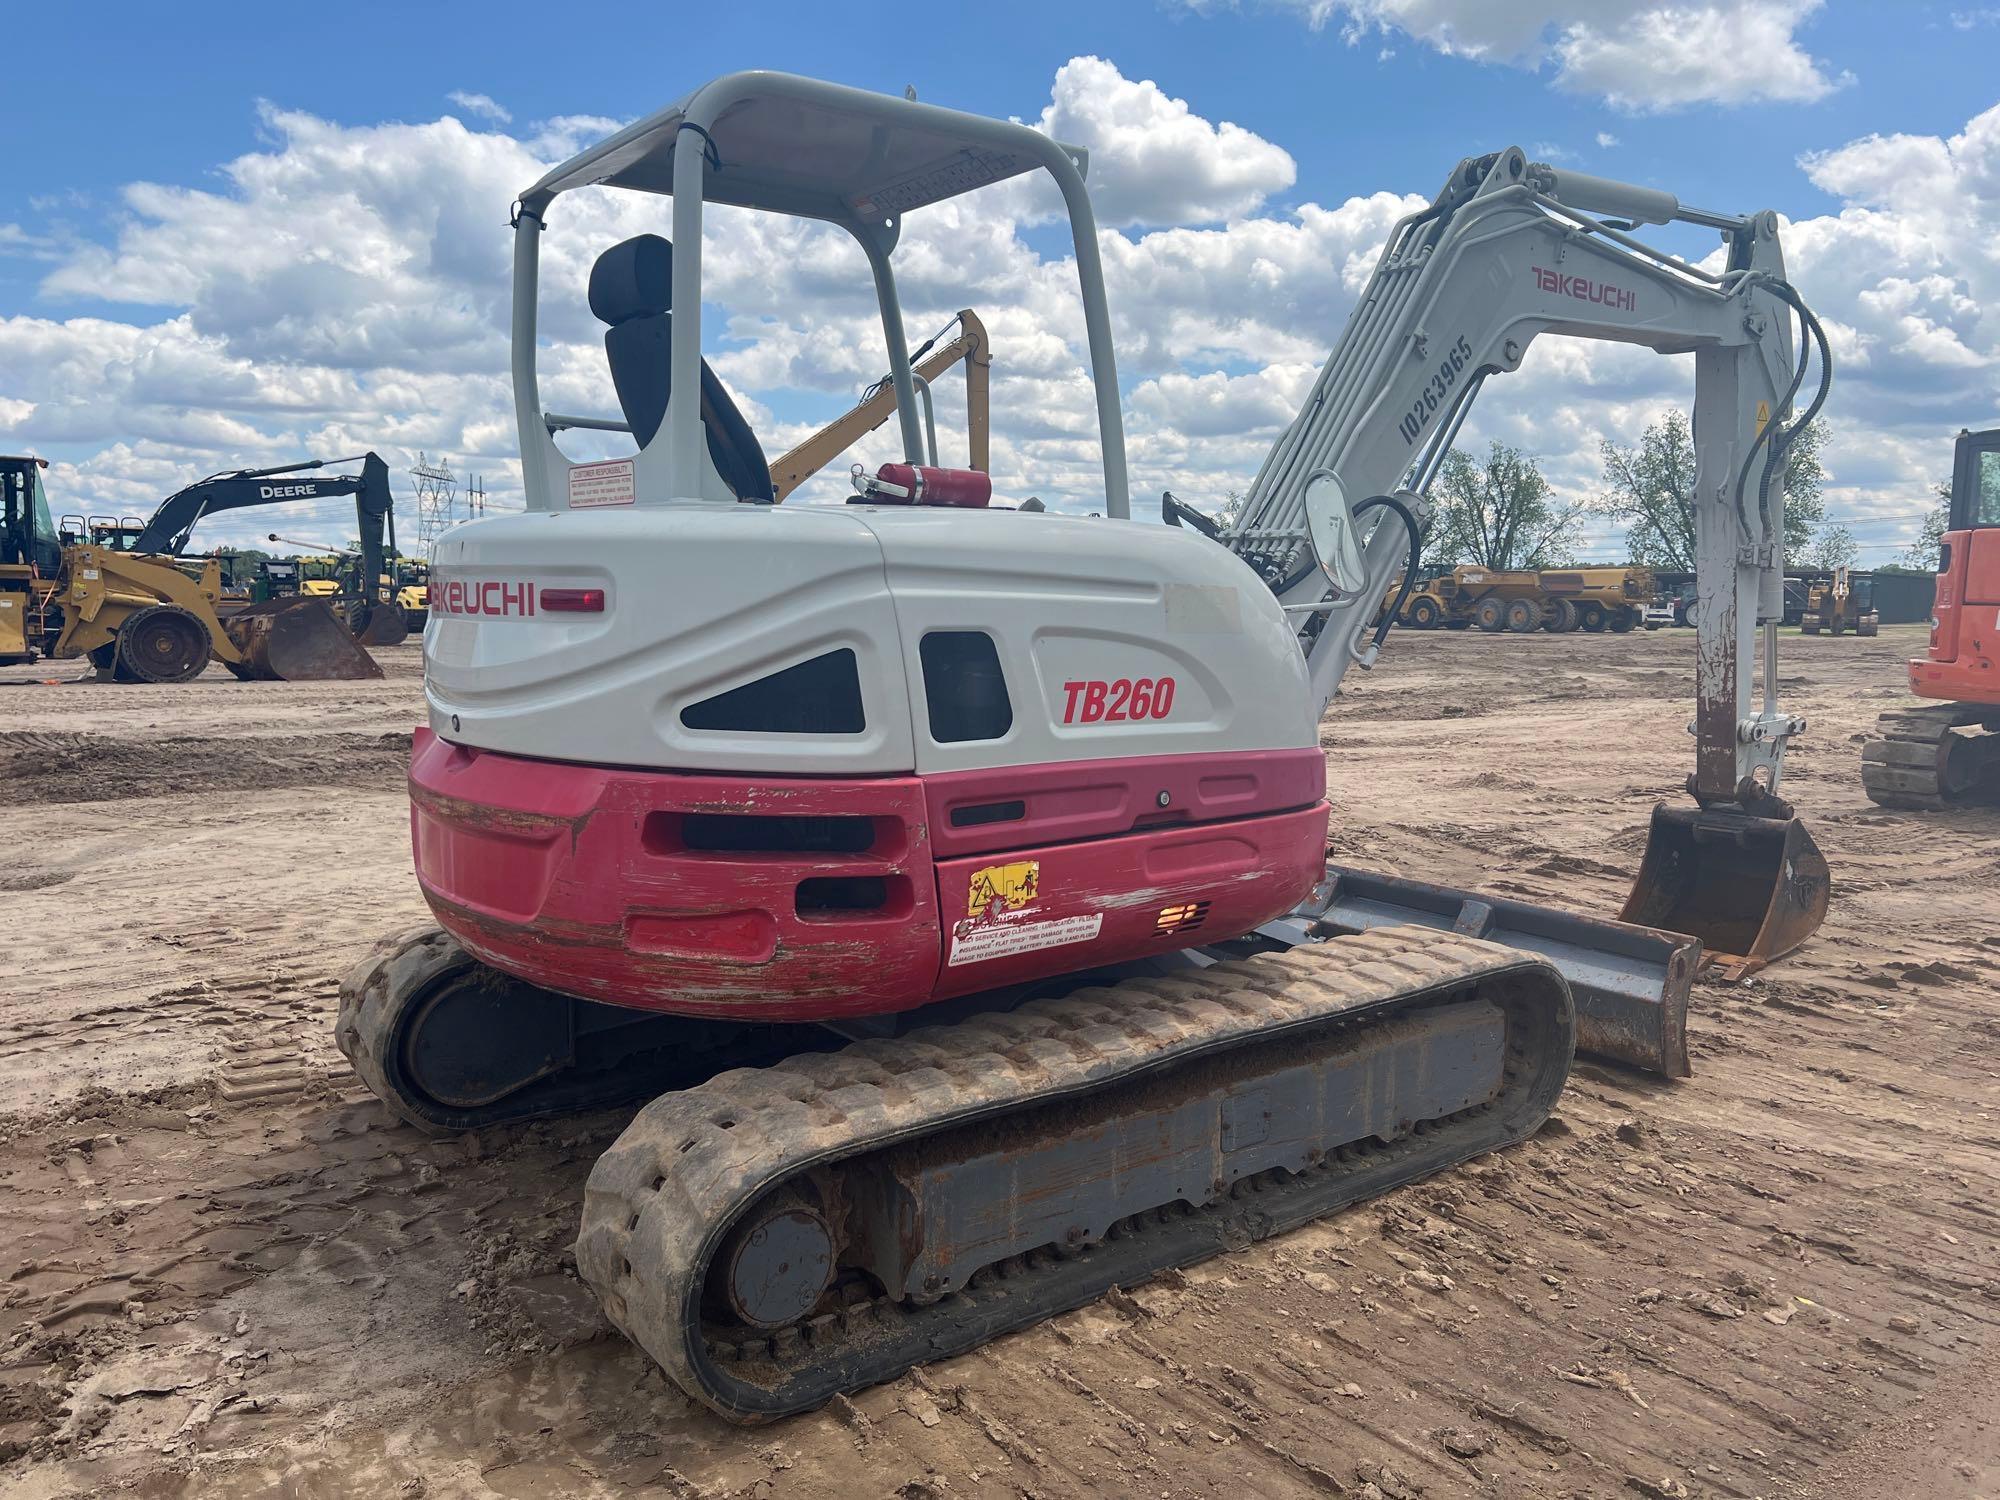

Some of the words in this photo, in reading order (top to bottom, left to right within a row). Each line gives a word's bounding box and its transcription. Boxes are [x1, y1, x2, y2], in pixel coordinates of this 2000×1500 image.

[1399, 335, 1473, 446] 10263965
[260, 484, 317, 499] DEERE
[1063, 677, 1176, 724] TB260
[995, 939, 1009, 948] FLAT
